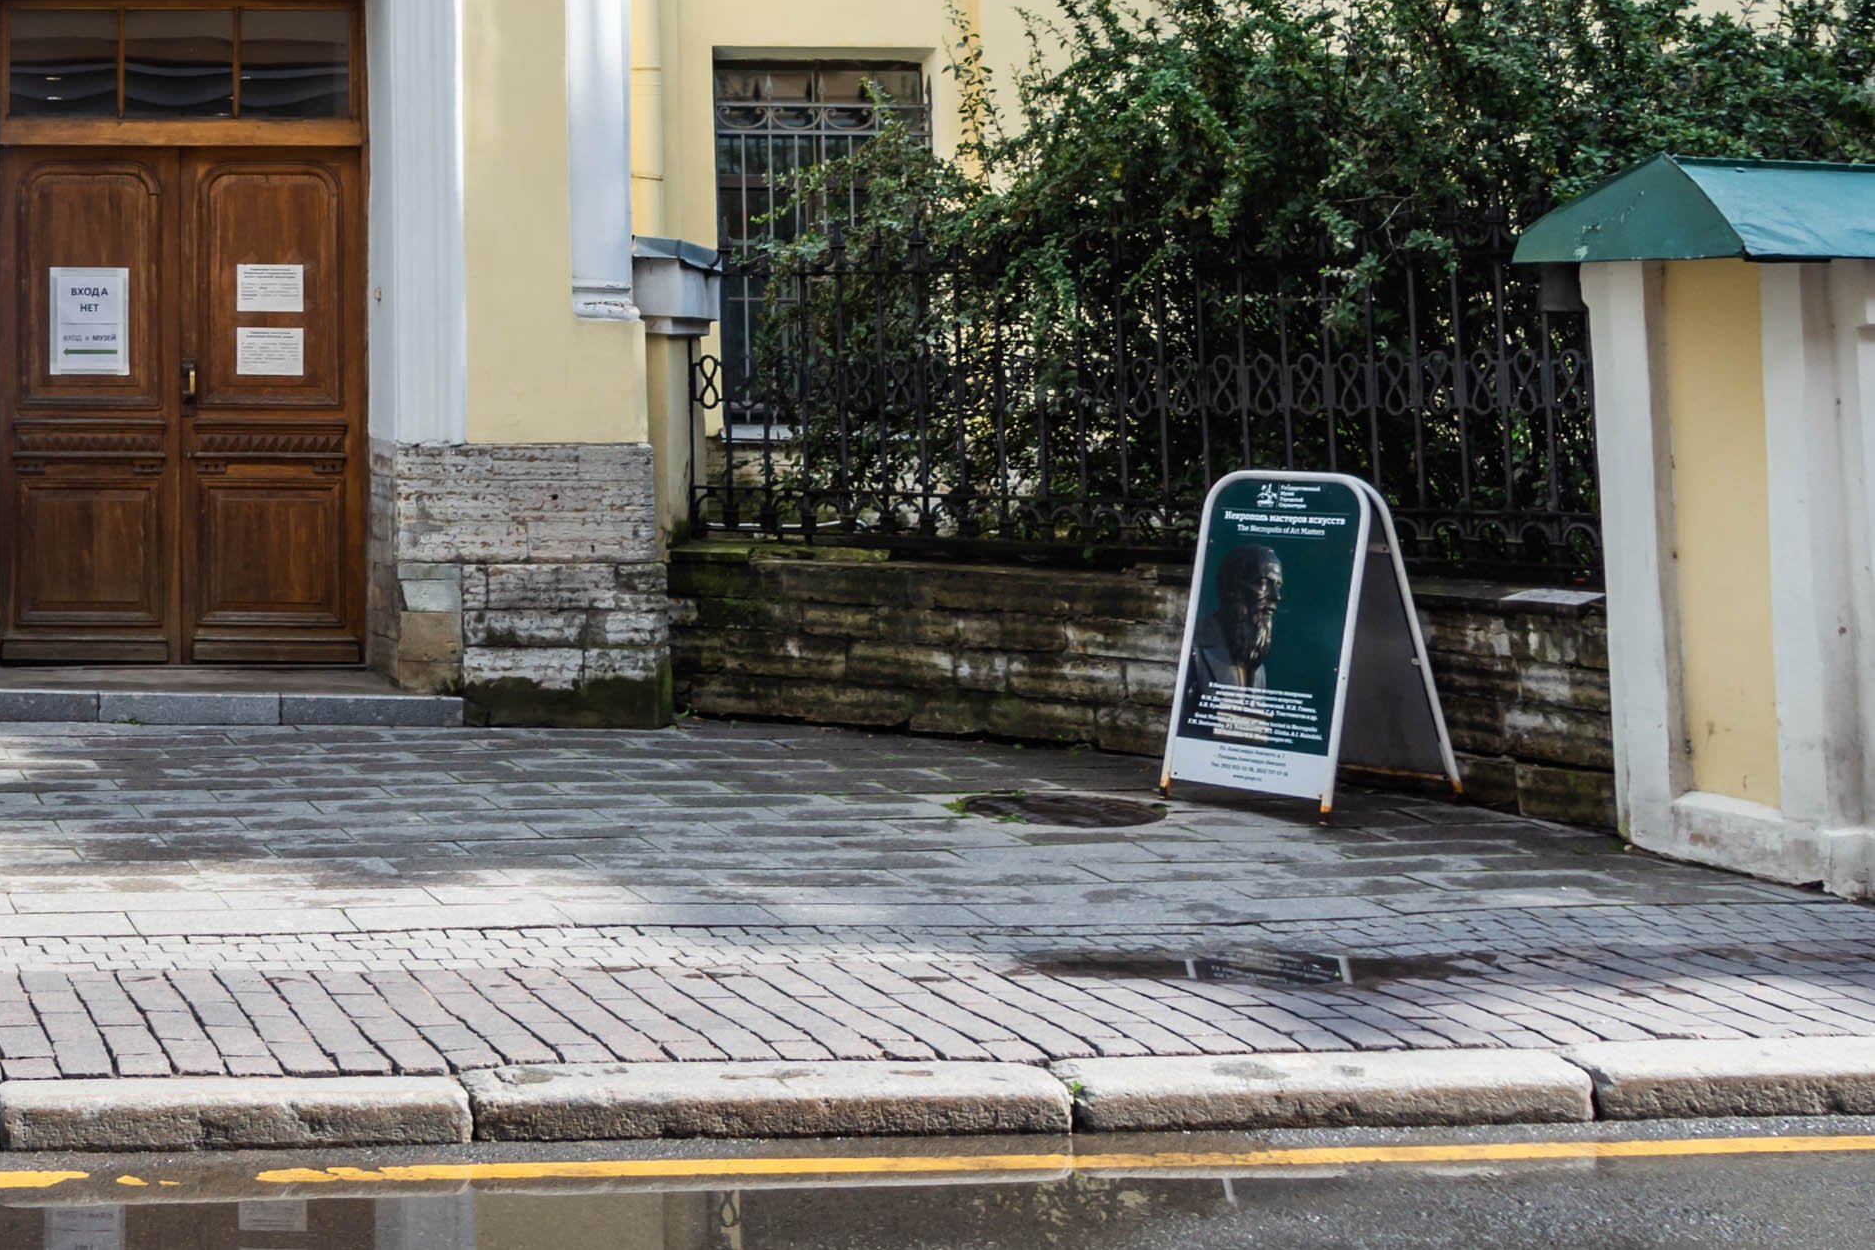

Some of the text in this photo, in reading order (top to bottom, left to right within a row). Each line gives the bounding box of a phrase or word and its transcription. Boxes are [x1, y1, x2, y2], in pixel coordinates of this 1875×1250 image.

[70, 287, 109, 298] ВХОДА
[80, 303, 100, 313] НЕТ
[1237, 523, 1250, 532] The
